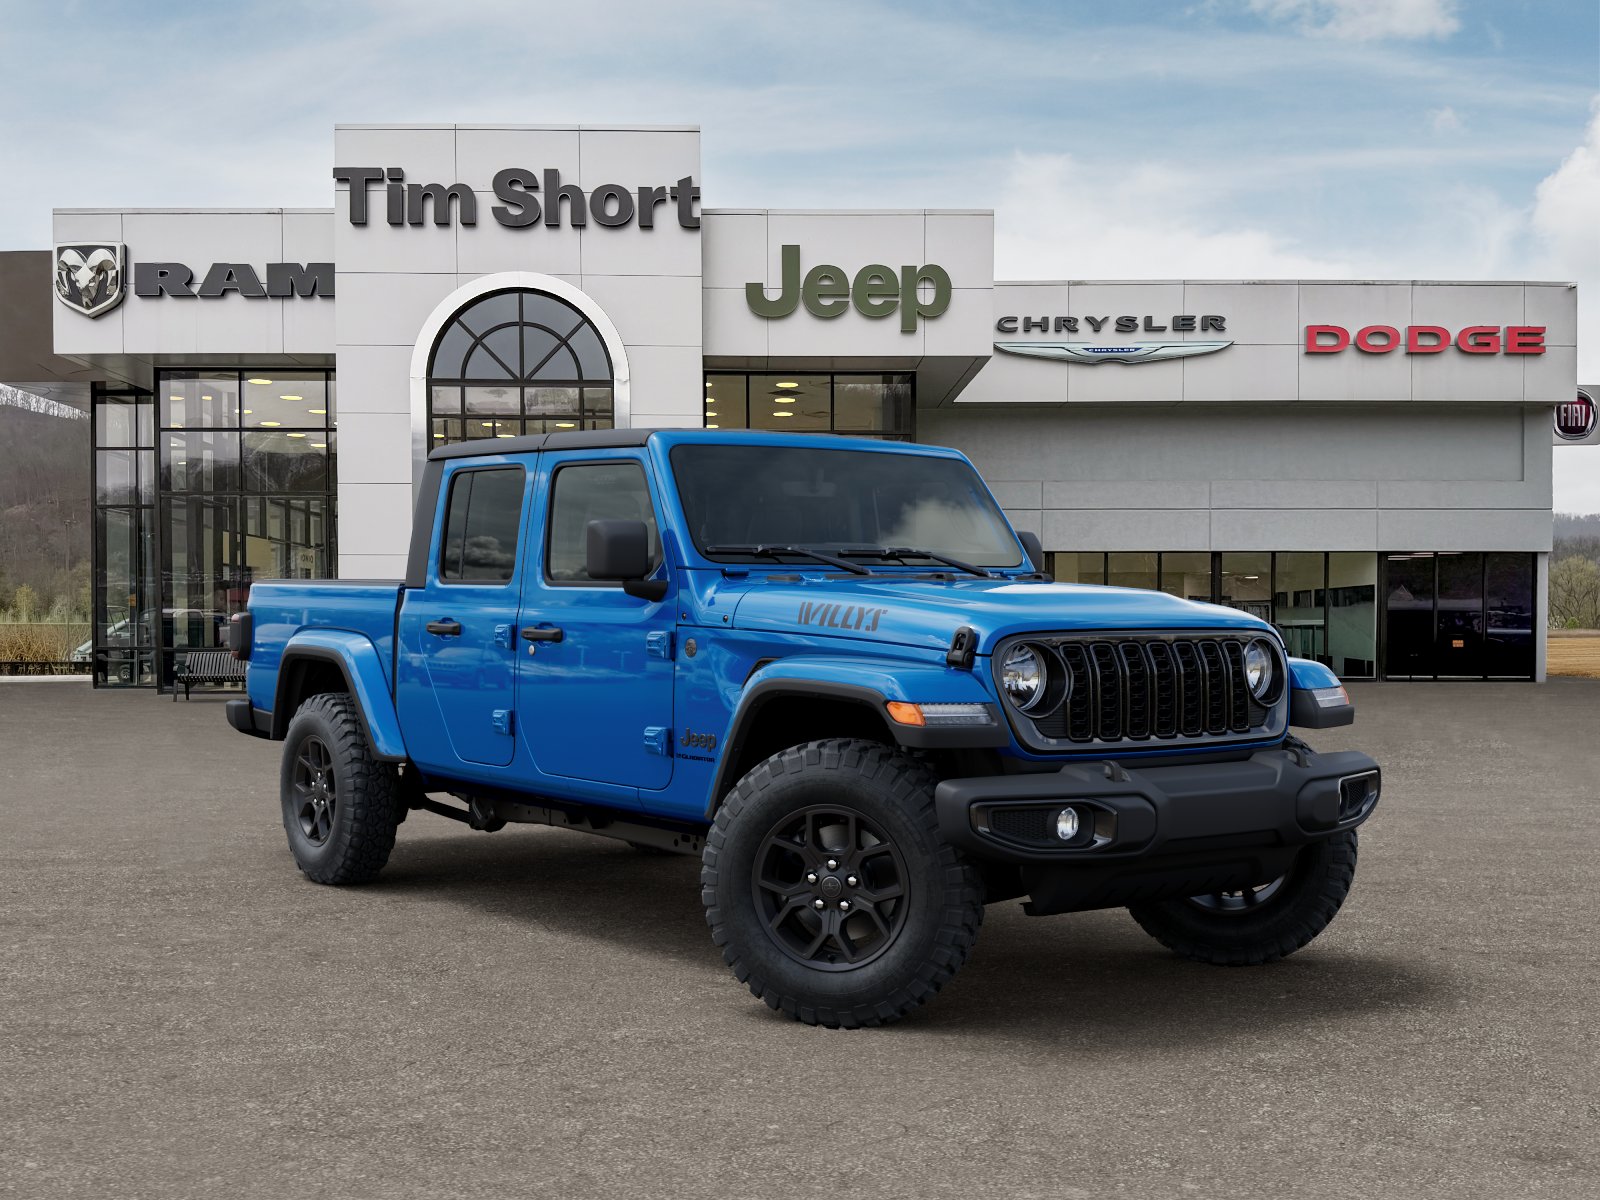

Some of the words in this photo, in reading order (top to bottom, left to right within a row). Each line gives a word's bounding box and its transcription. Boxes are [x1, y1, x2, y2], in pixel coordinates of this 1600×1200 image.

[333, 167, 477, 227] Tim
[491, 167, 701, 230] Short
[134, 262, 336, 299] RAM
[745, 244, 952, 333] Jeep
[997, 315, 1227, 333] CHRYSLER
[1304, 325, 1547, 355] DODGE
[1560, 404, 1586, 427] FIAT
[680, 727, 717, 752] Jeep
